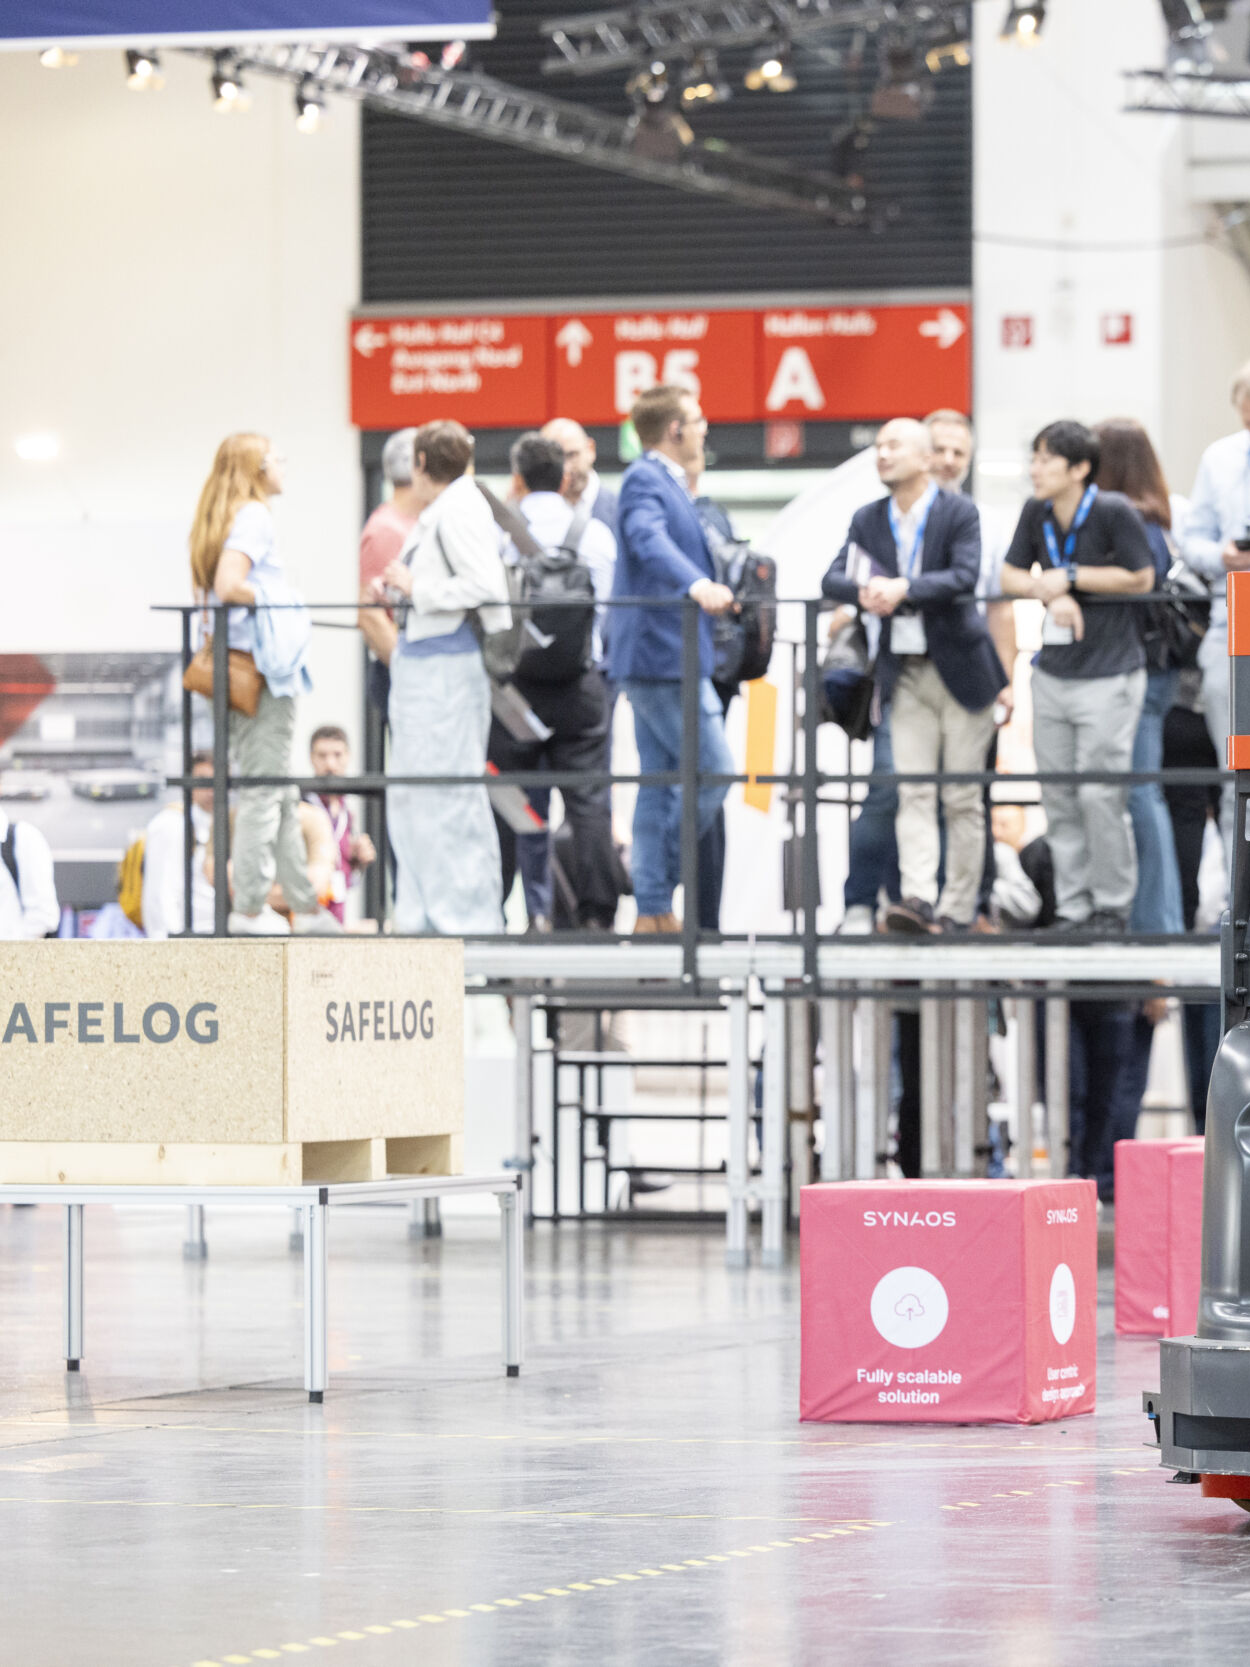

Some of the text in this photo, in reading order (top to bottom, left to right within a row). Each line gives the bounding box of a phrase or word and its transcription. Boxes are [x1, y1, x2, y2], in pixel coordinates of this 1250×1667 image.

[766, 347, 825, 411] A
[2, 1002, 219, 1044] AFELOG
[326, 1000, 434, 1043] SAFELOG
[863, 1211, 957, 1227] SYNAOS
[1046, 1208, 1078, 1224] SYNAOS
[857, 1368, 962, 1386] Fully scalable
[877, 1388, 940, 1404] solution
